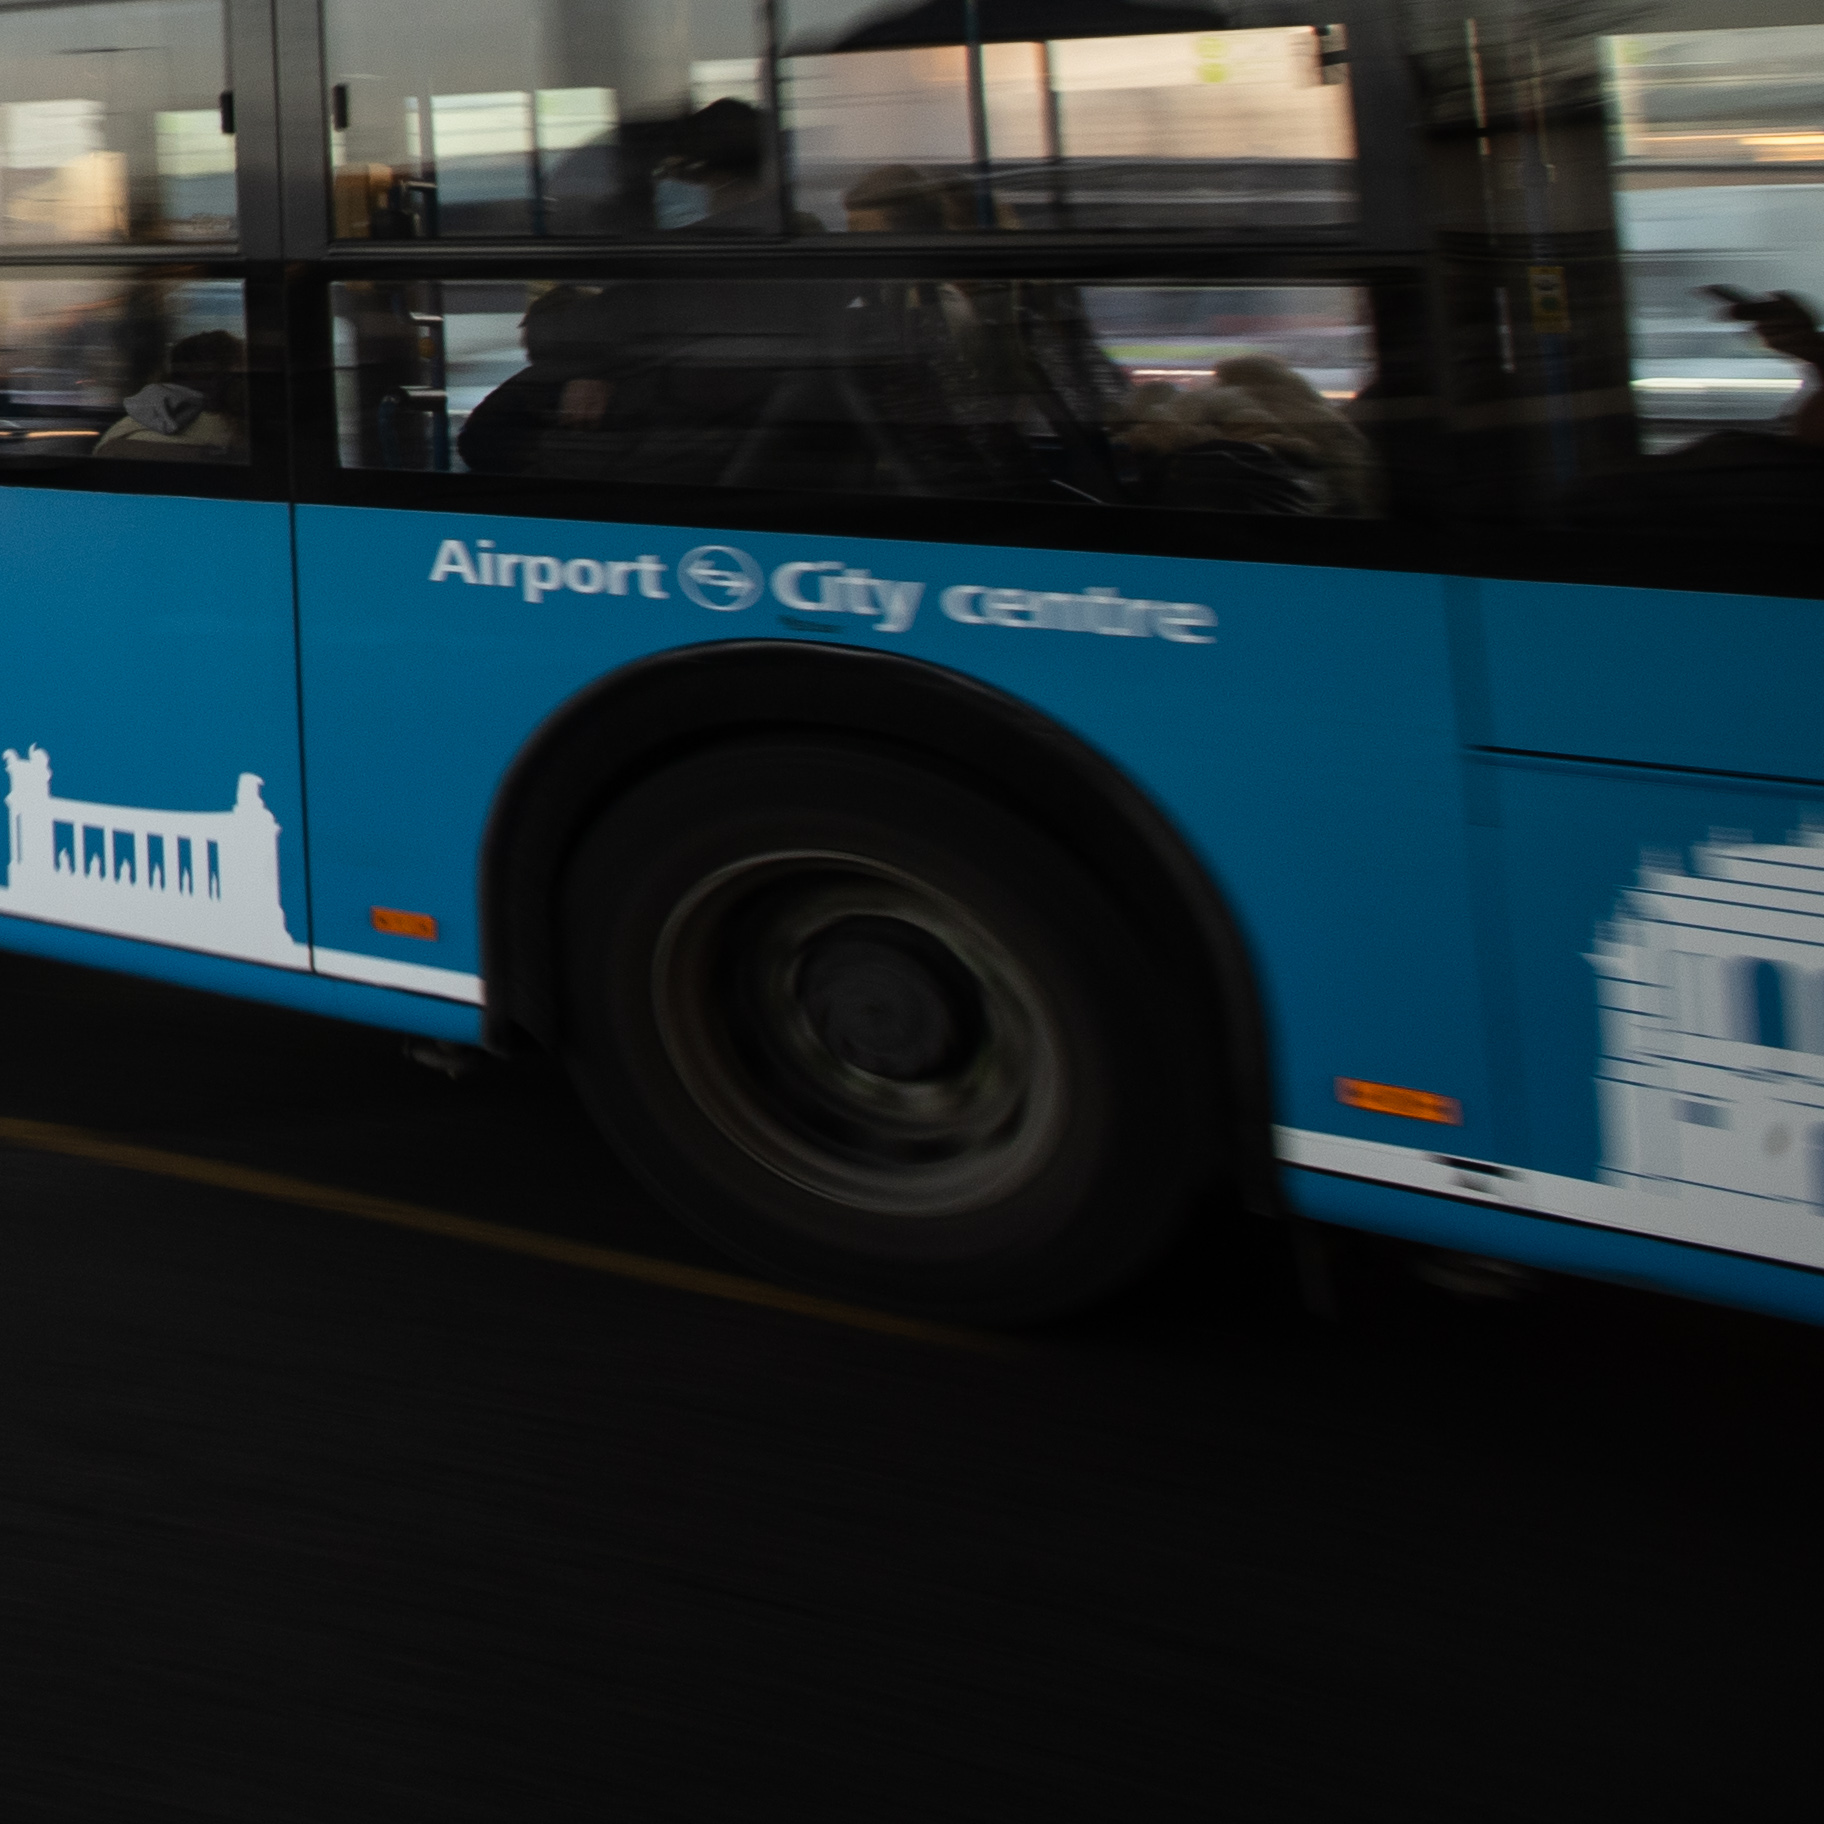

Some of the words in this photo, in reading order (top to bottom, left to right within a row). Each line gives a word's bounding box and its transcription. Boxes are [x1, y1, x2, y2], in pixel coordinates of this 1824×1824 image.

[428, 539, 670, 604] Airport
[770, 560, 926, 633] City
[939, 584, 1219, 644] centre
